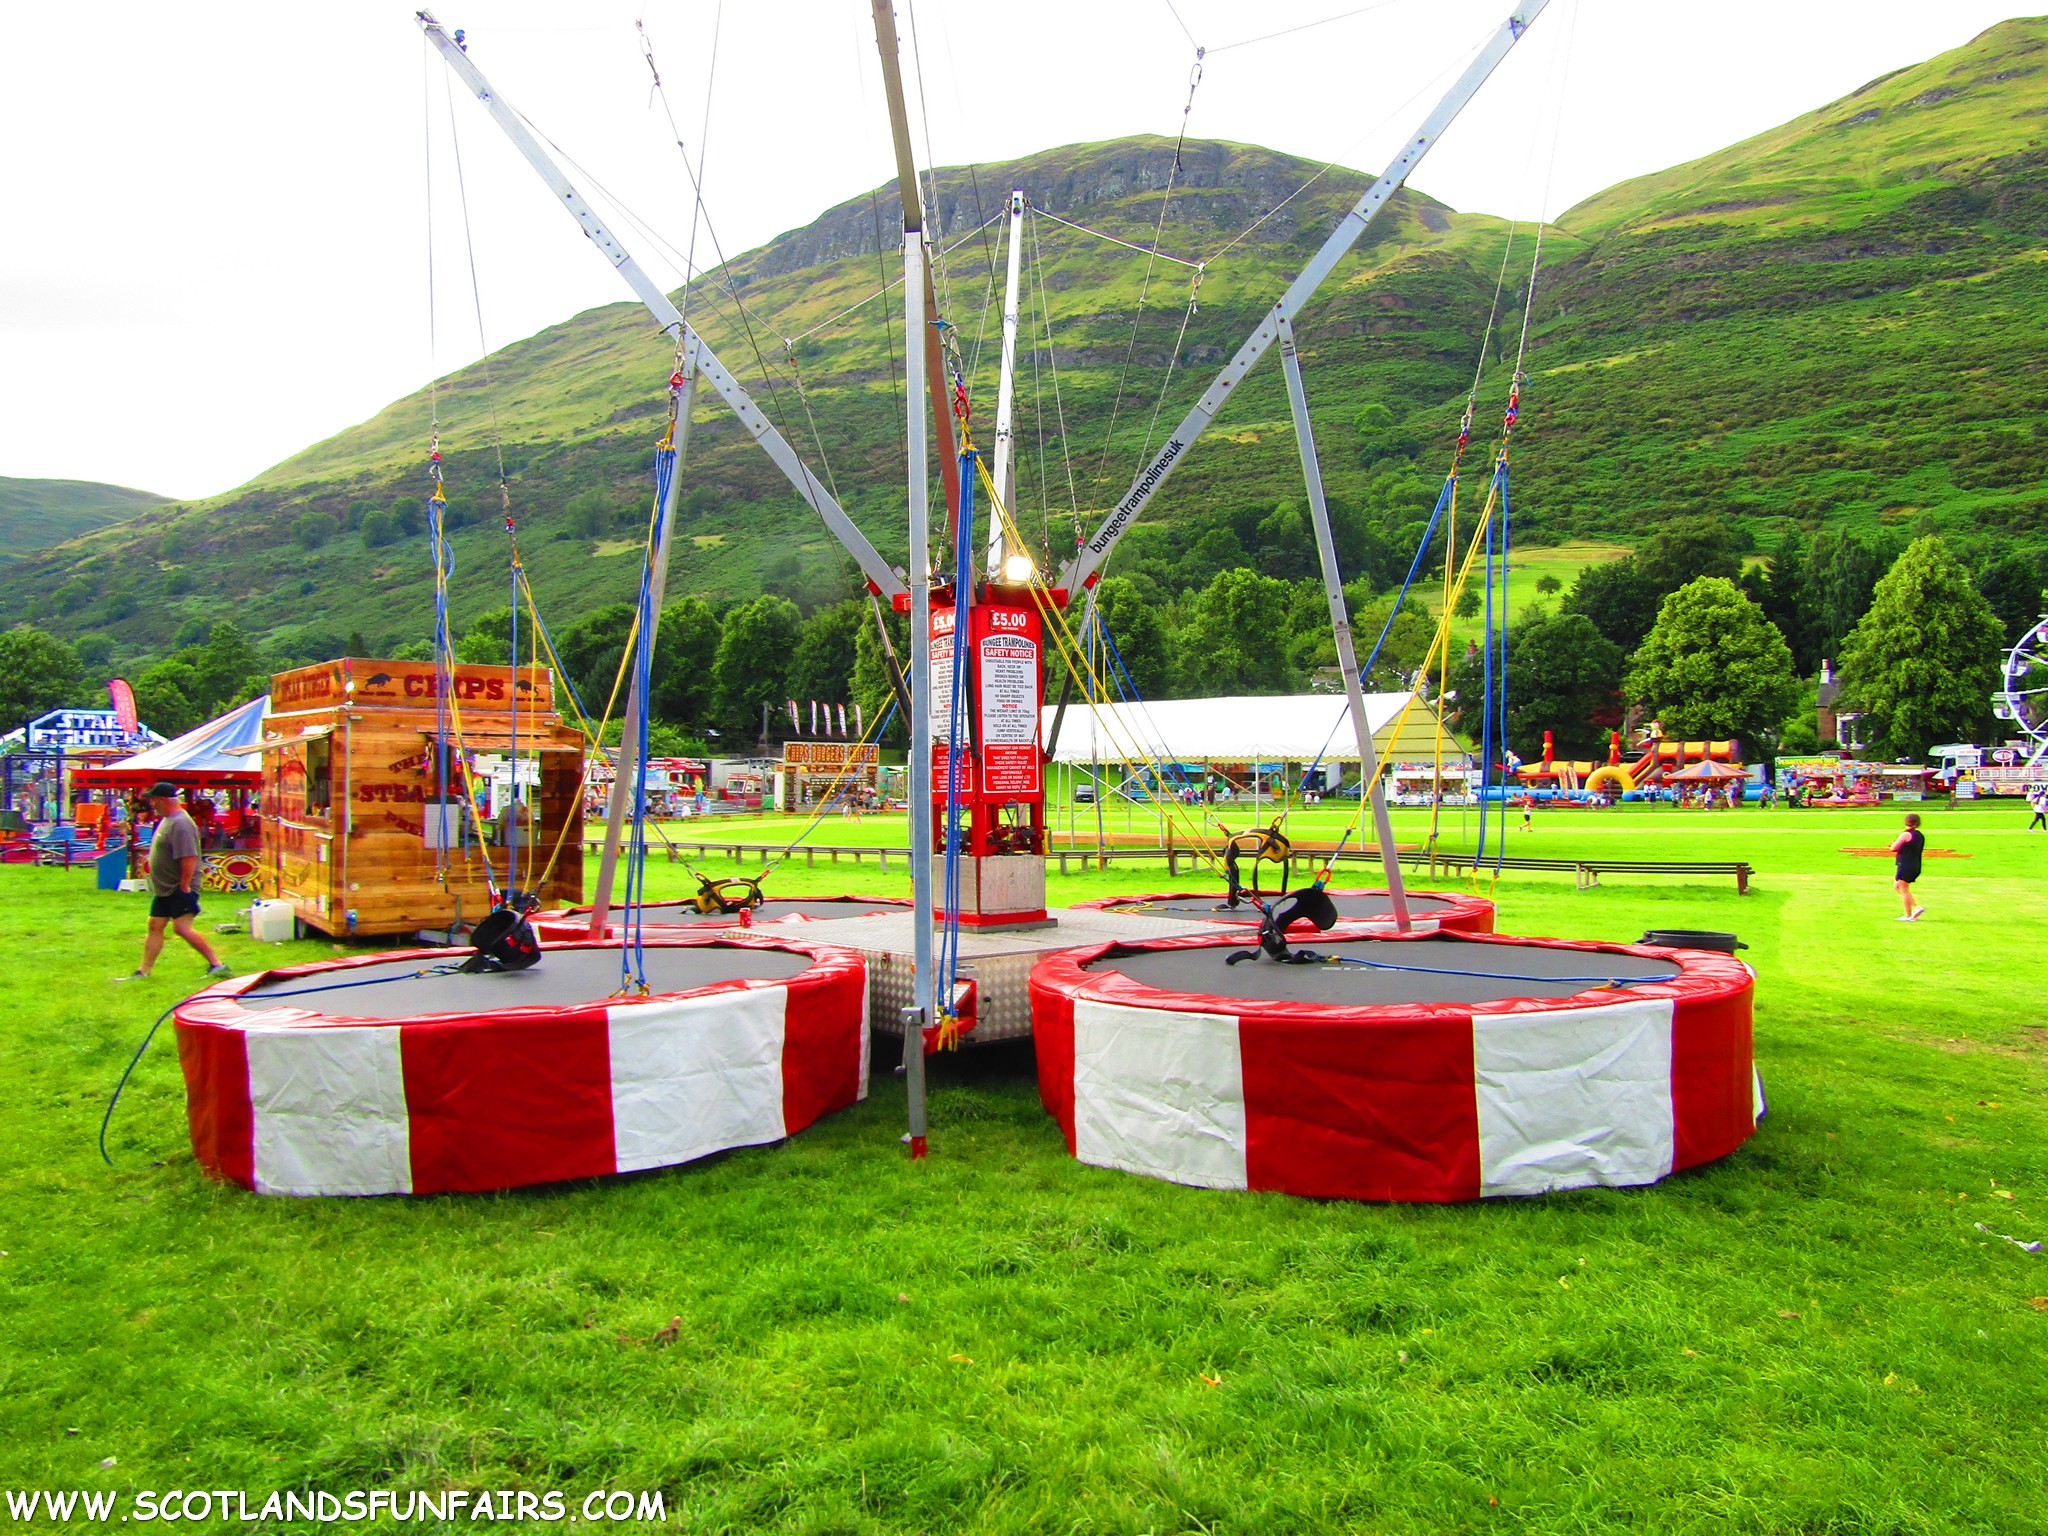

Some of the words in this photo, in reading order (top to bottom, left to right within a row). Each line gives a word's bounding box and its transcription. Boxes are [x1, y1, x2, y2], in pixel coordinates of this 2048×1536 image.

[1089, 439, 1184, 553] bungeetrampolinesuk
[993, 612, 1026, 627] £5.00
[983, 638, 1001, 646] BUNGEE
[1002, 637, 1035, 648] TRAMPOLINES
[985, 648, 1009, 656] SAFETY
[1011, 649, 1032, 658] NOTICE
